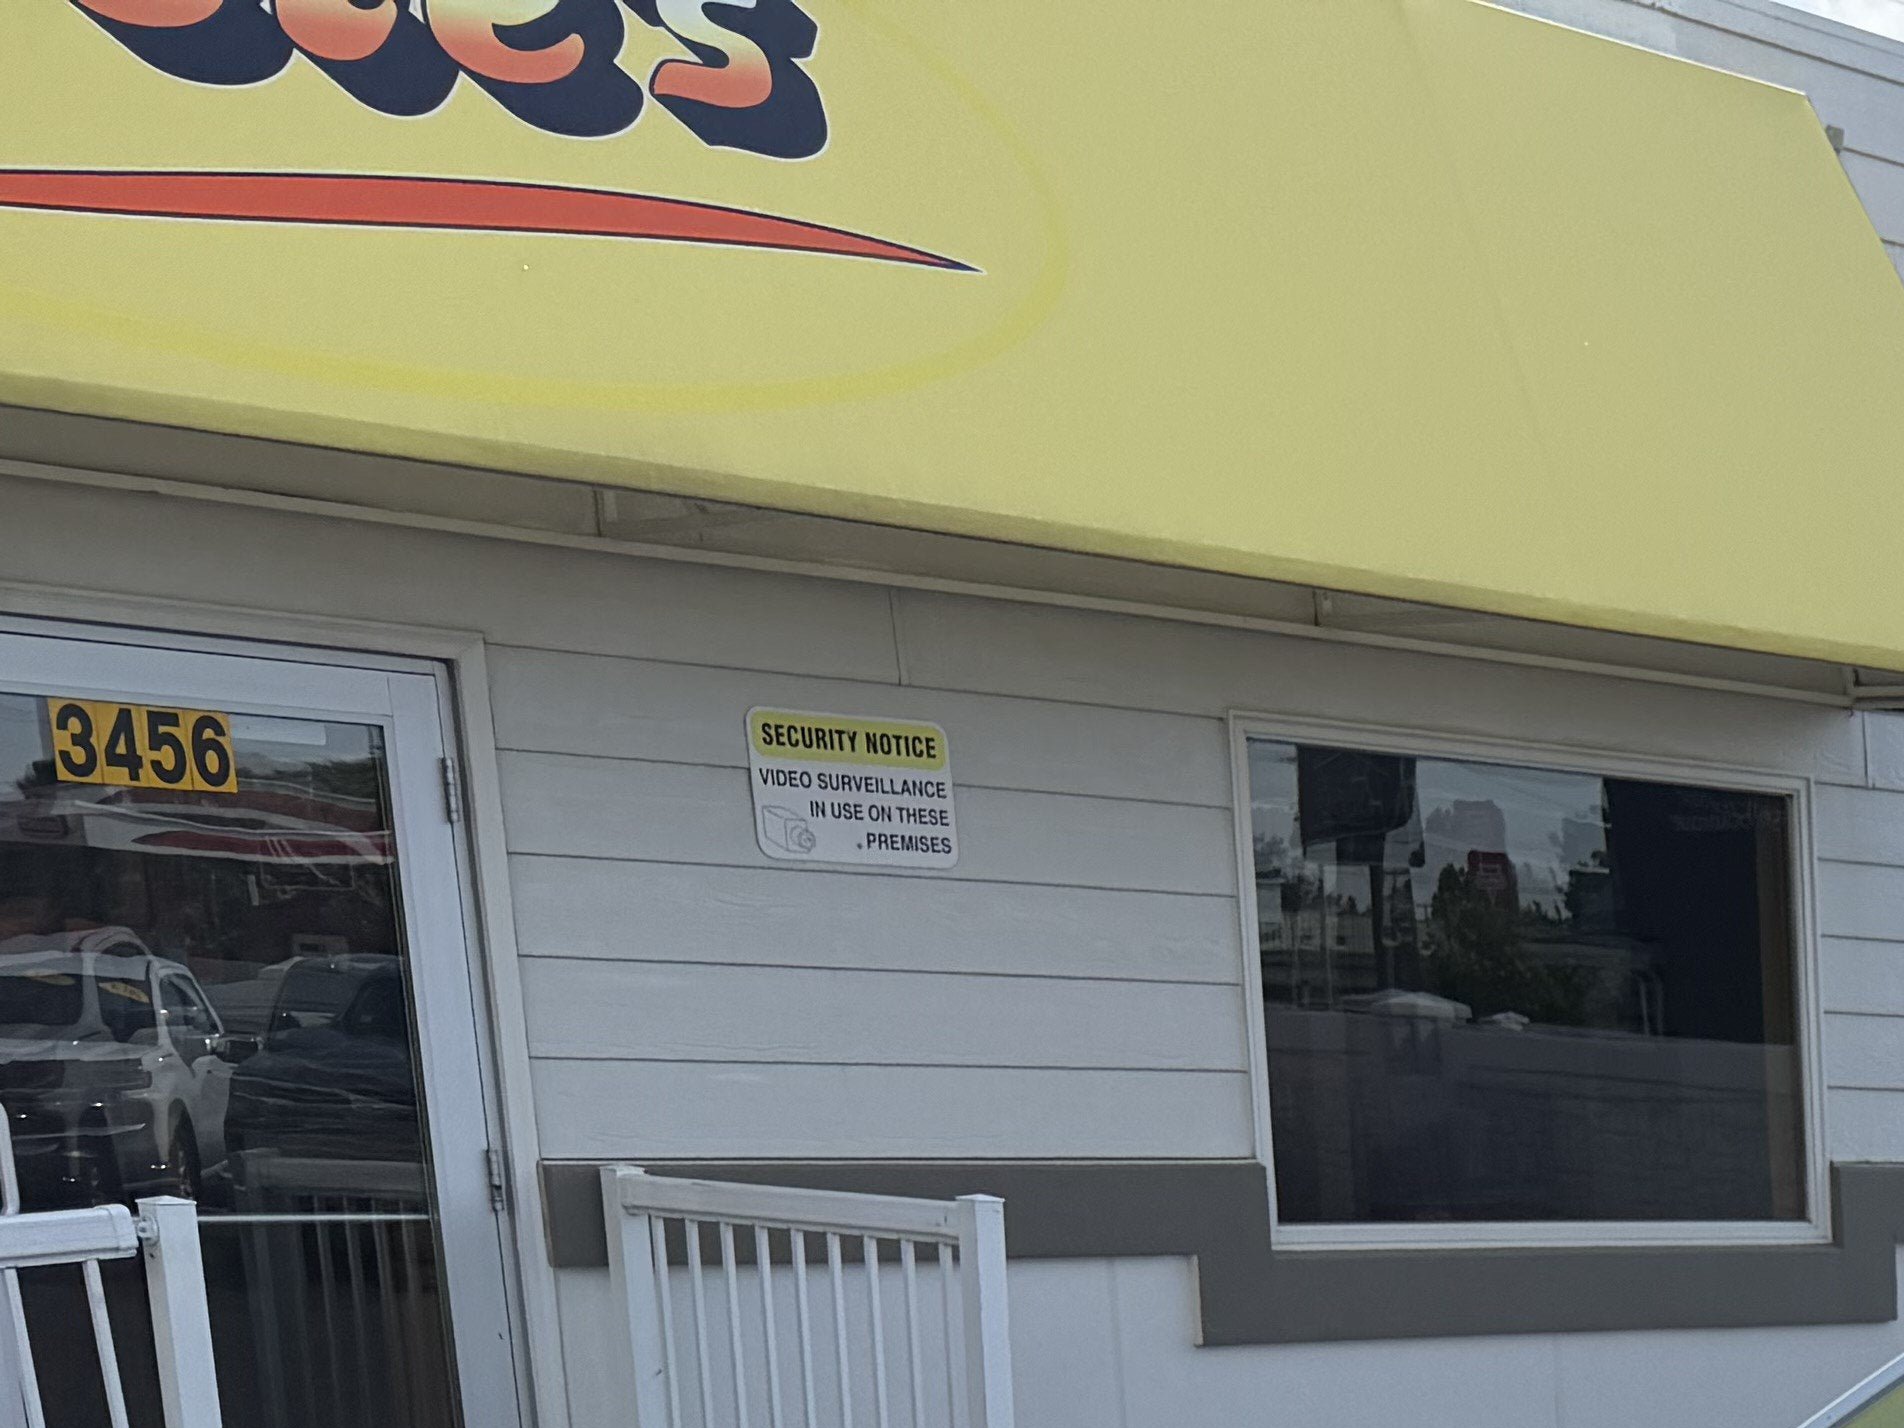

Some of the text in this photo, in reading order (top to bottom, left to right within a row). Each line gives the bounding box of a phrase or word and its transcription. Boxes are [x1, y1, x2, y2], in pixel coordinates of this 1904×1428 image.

[56, 704, 231, 787] 3456
[761, 722, 936, 759] SECURITY NOTICE
[759, 768, 947, 799] VIDEO SURVEILLANCE
[810, 801, 949, 827] IN USE ON THESE
[866, 832, 952, 854] PREMISES
